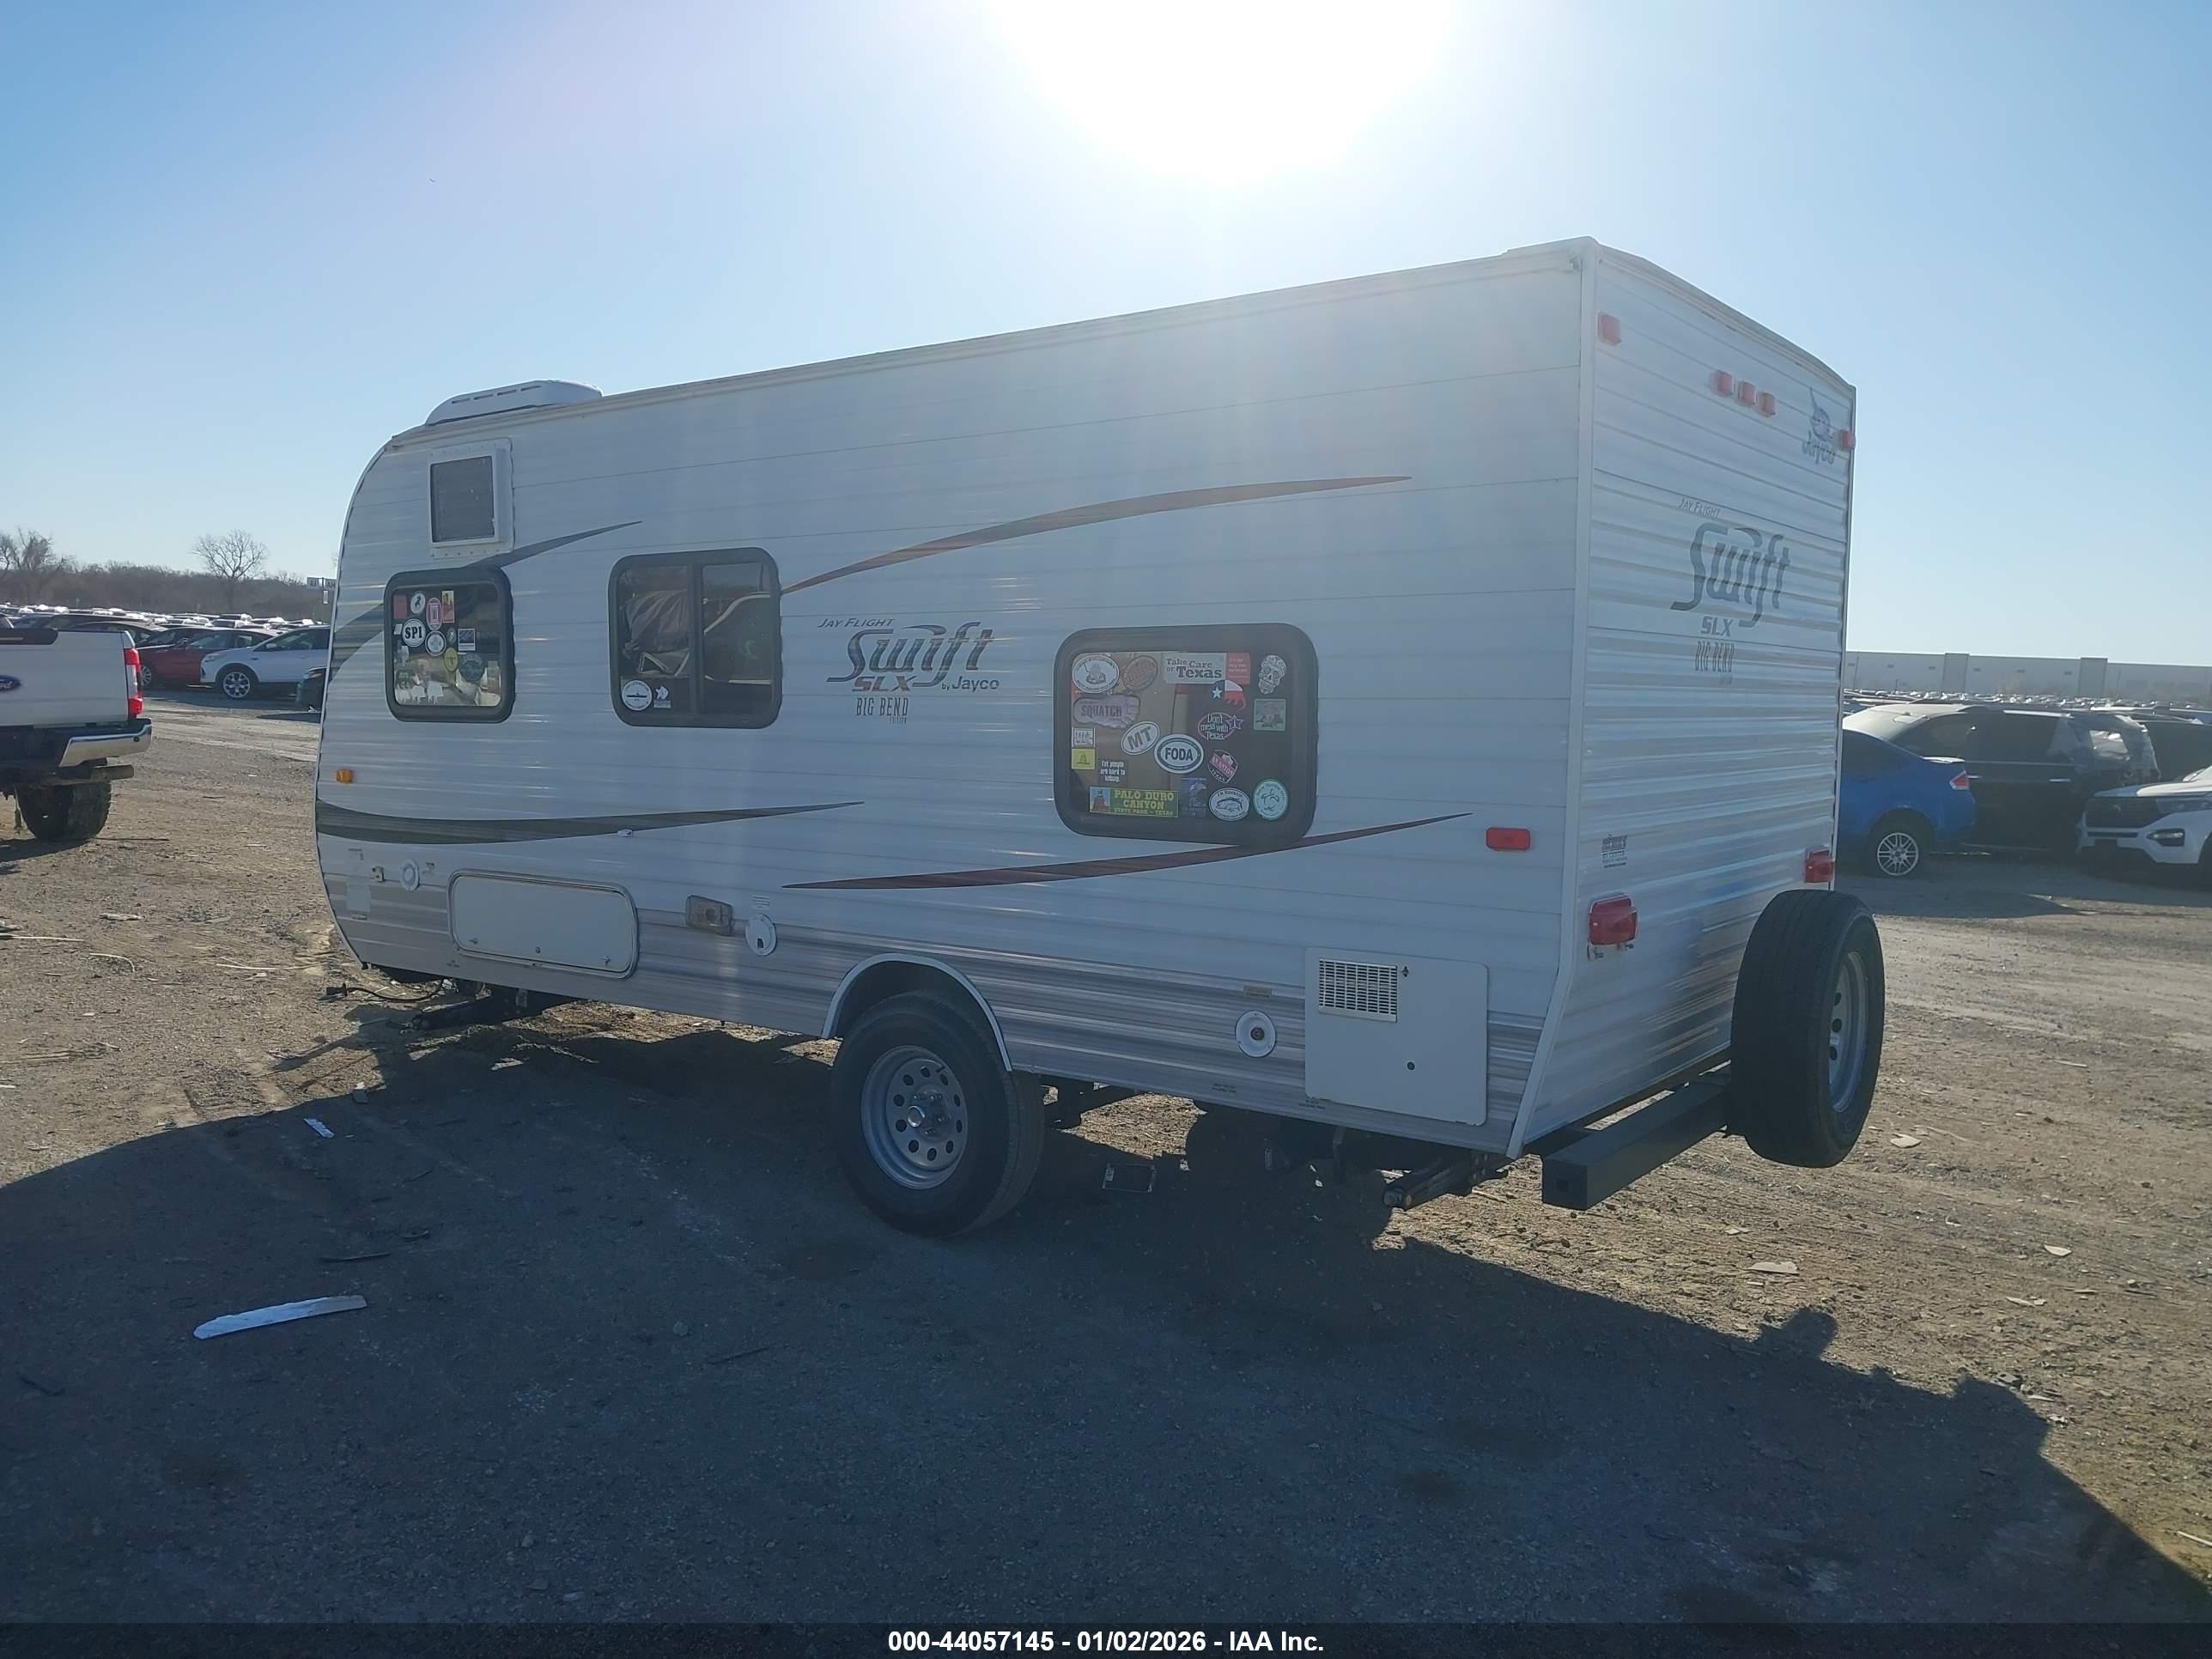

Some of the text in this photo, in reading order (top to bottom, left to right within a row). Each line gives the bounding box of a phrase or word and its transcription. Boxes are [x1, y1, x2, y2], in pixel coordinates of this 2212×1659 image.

[1670, 522, 1790, 628] Swift
[817, 617, 896, 628] JAY FLIGHT
[1700, 616, 1733, 636] SLX
[404, 627, 422, 638] SPI
[826, 622, 994, 687] Swift
[1166, 658, 1212, 672] Take Care
[1176, 666, 1223, 679] Texas
[852, 676, 918, 692] SLX
[951, 676, 1000, 693] Jayco
[856, 697, 908, 716] BIG BEND
[1080, 705, 1123, 719] SQUATCH
[1126, 726, 1153, 750] MT
[1206, 732, 1224, 741] Texas
[1164, 747, 1194, 762] FODA
[1113, 789, 1175, 802] PALO DURO
[1123, 799, 1165, 810] CANYON
